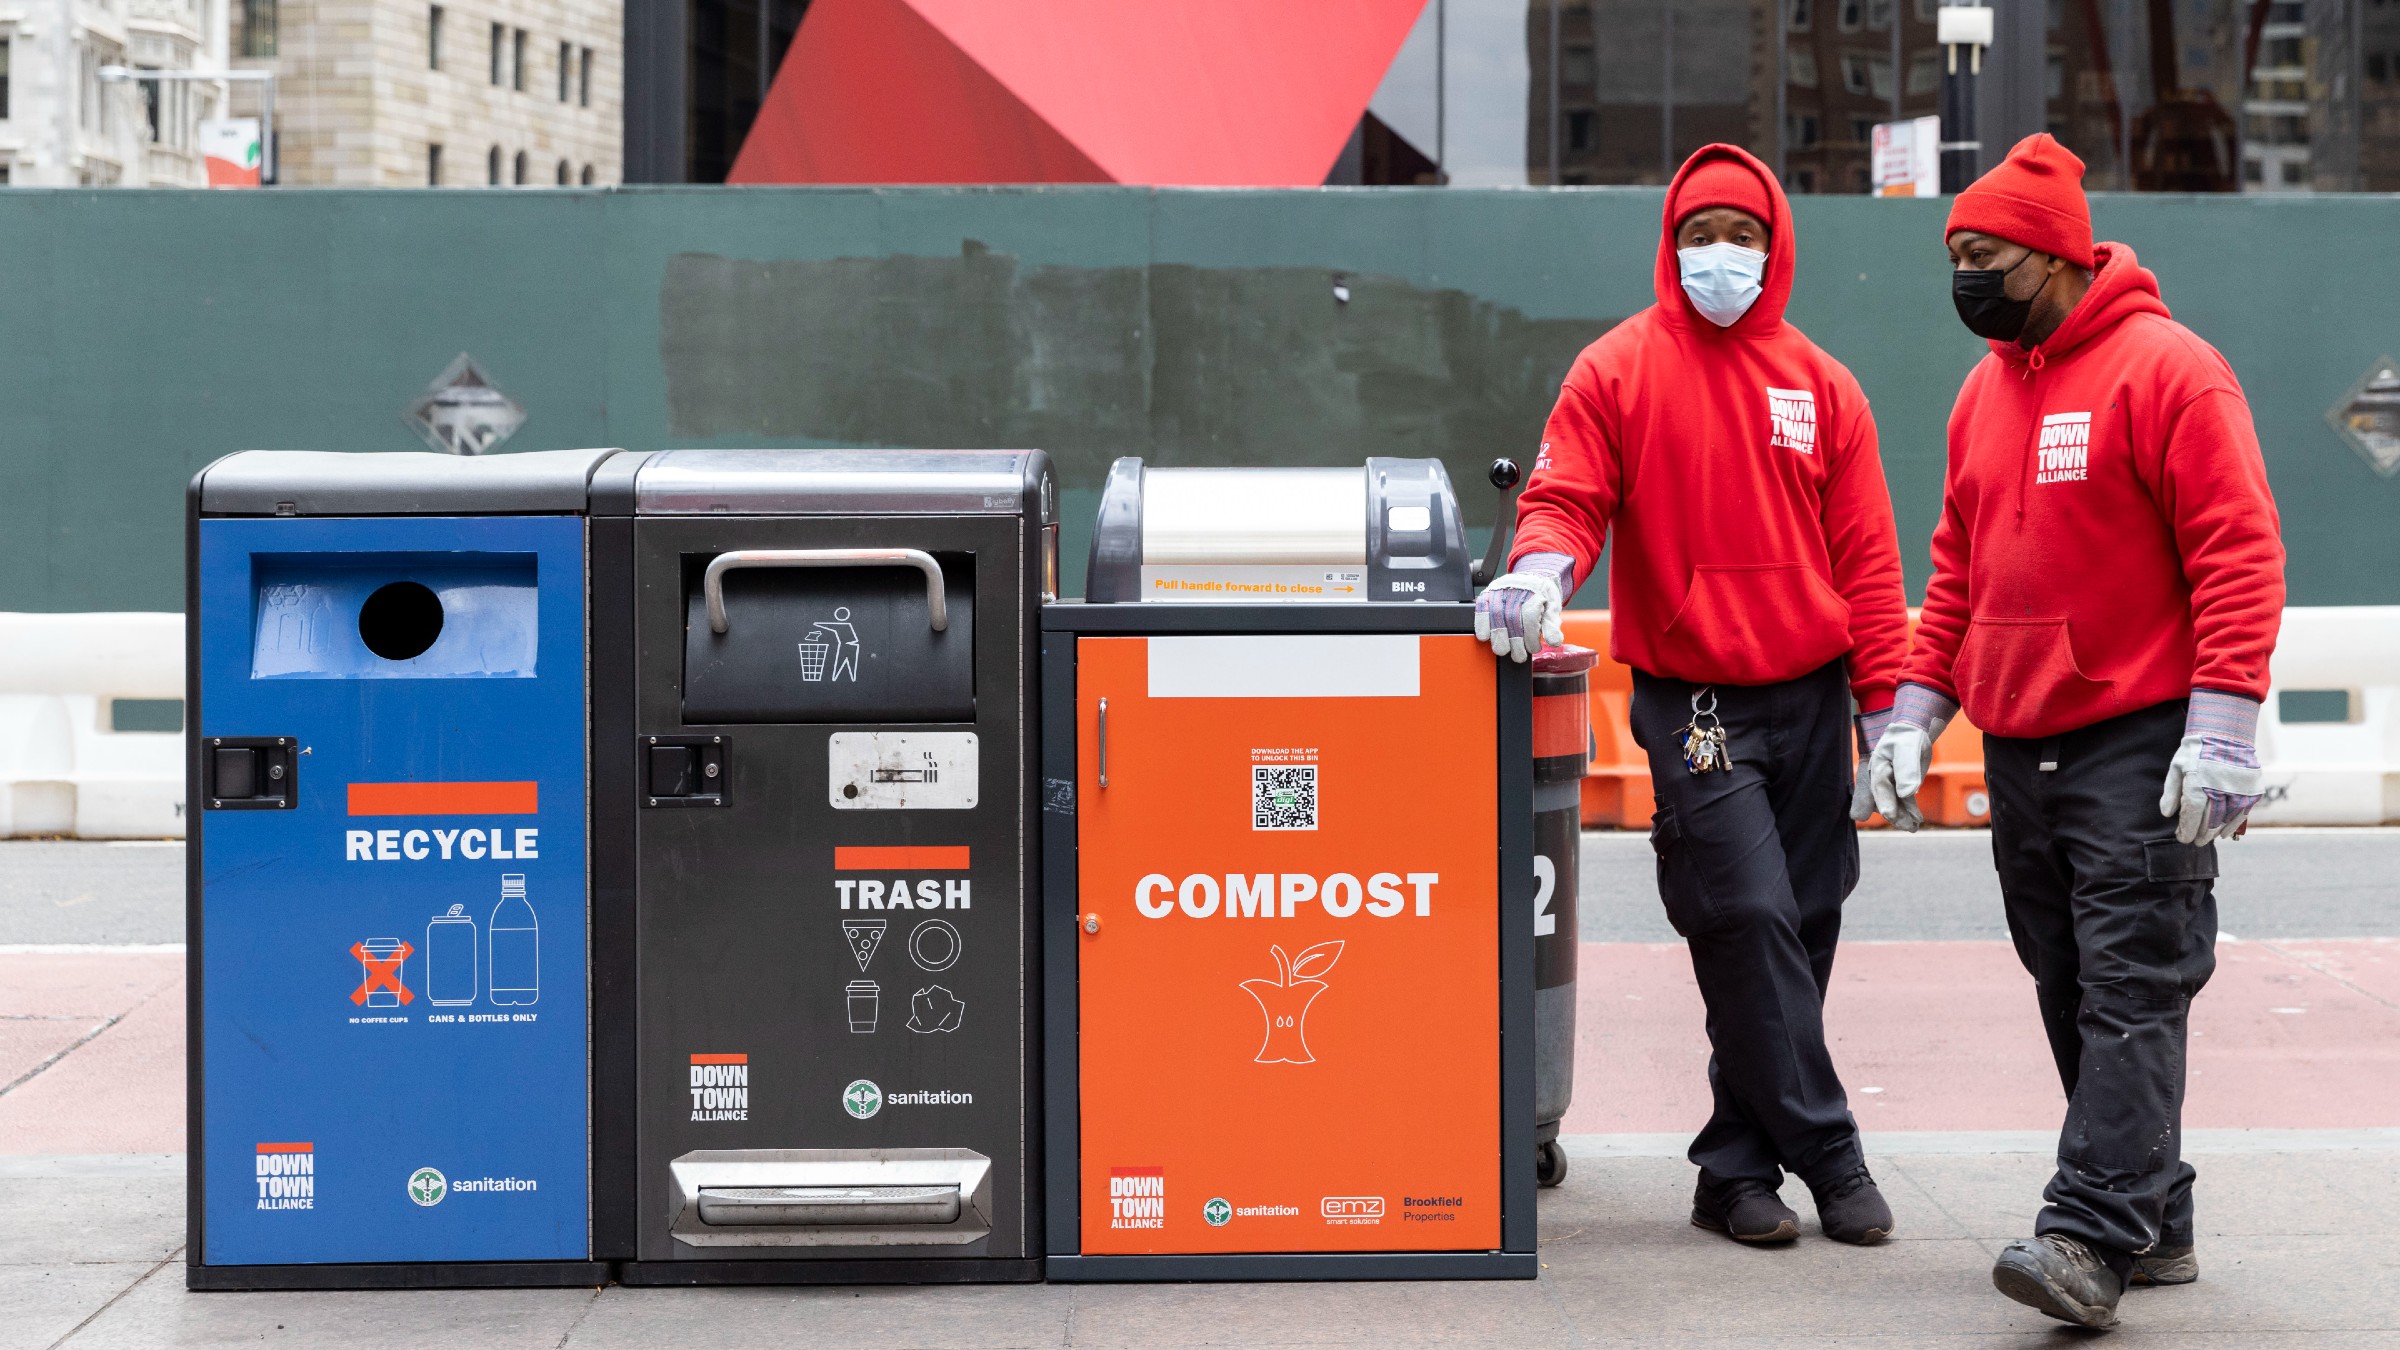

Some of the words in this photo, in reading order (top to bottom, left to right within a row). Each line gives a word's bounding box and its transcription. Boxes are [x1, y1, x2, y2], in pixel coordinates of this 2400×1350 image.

[1769, 396, 1816, 422] DOWN
[1770, 415, 1816, 443] TOWN
[2039, 423, 2090, 448] DOWN
[1770, 435, 1814, 455] ALLIANCE
[2038, 446, 2088, 471] TOWN
[2036, 469, 2088, 484] ALLIANCE
[1155, 579, 1178, 590] Pull
[1181, 580, 1222, 591] handle
[1225, 582, 1272, 592] forward
[1275, 583, 1287, 593] to
[1290, 584, 1323, 593] close
[1391, 581, 1426, 592] BIN-8
[346, 828, 539, 860] RECYCLE
[835, 879, 971, 910] TRASH
[1135, 872, 1439, 919] COMPOST
[428, 1015, 455, 1023] CANS
[468, 1014, 510, 1022] BOTTLES
[513, 1014, 537, 1022] ONLY
[690, 1065, 748, 1087] DOWN
[690, 1088, 748, 1109] TOWN
[888, 1090, 973, 1105] sanitation
[690, 1110, 748, 1121] ALLIANCE
[256, 1154, 314, 1176] DOWN
[256, 1176, 314, 1198] TOWN
[453, 1177, 537, 1192] sanitation
[1111, 1177, 1164, 1197] DOWN
[257, 1199, 314, 1210] ALLIANCE
[1111, 1197, 1164, 1218] TOWN
[1236, 1205, 1299, 1216] sanitation
[1326, 1201, 1380, 1213] emz
[1404, 1197, 1462, 1207] Brookfield
[1111, 1218, 1164, 1229] ALLIANCE
[1404, 1212, 1455, 1223] Properties
